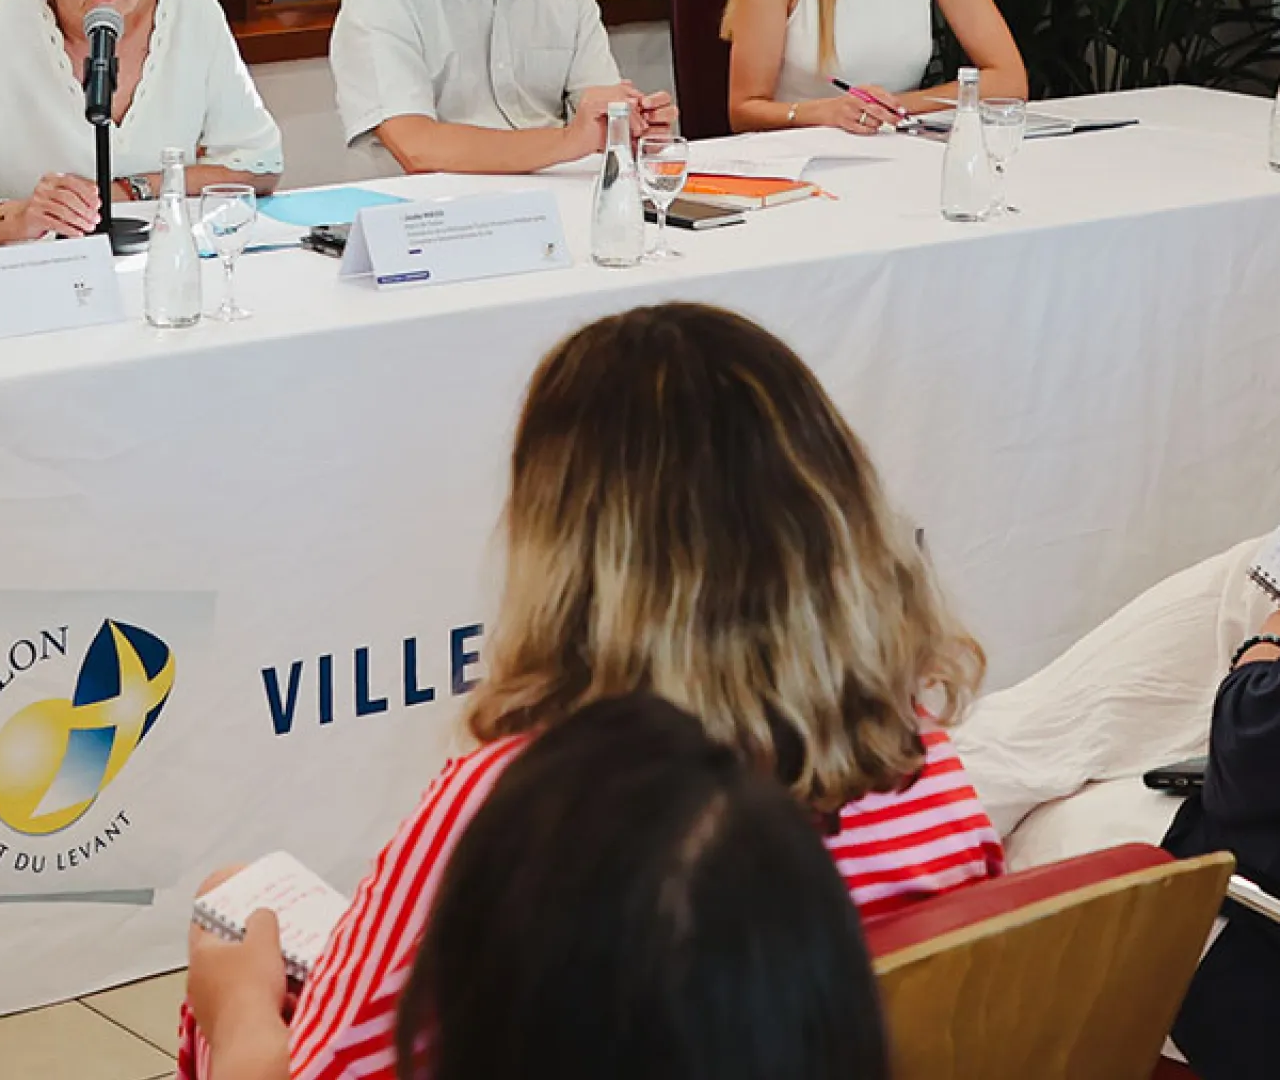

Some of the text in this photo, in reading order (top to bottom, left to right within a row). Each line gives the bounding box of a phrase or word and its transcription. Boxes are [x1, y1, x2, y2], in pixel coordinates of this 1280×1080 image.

[261, 623, 484, 735] VILLE
[14, 852, 46, 873] DU
[57, 810, 131, 871] LEVANT
